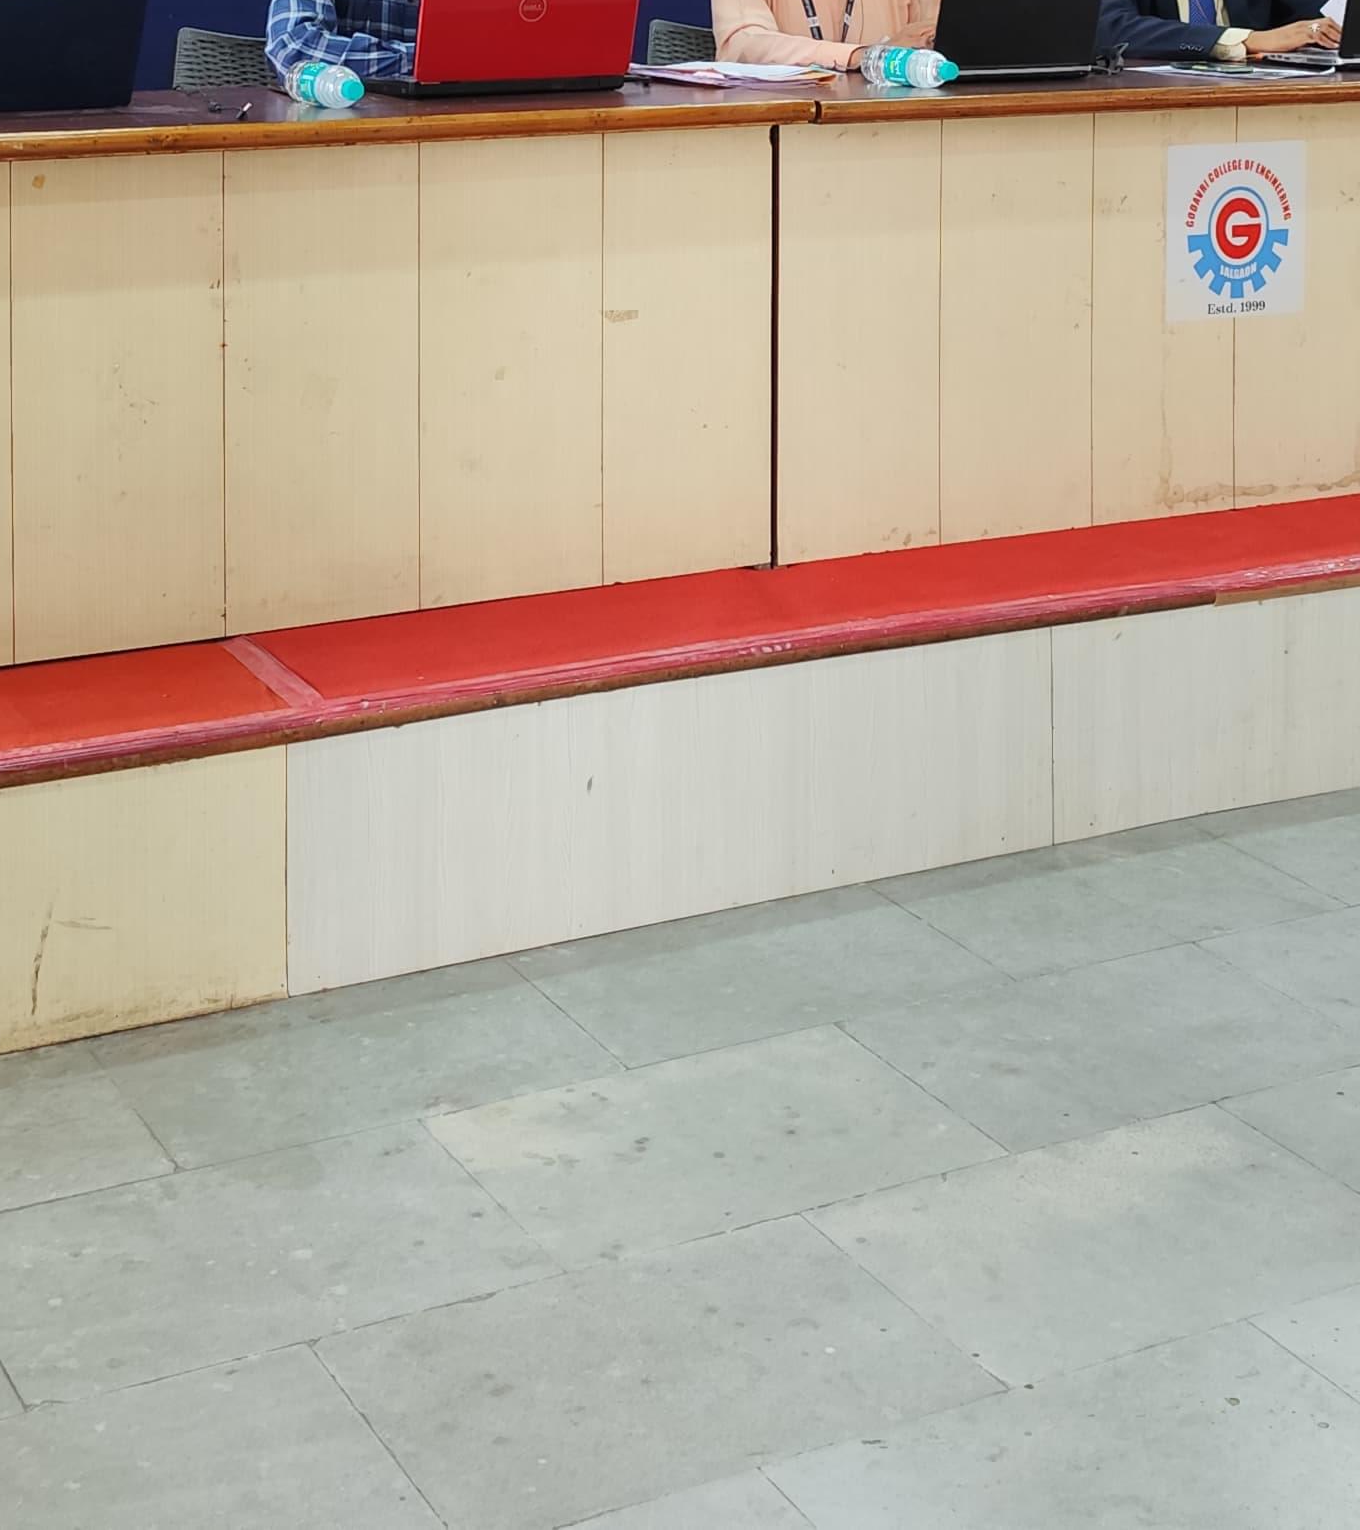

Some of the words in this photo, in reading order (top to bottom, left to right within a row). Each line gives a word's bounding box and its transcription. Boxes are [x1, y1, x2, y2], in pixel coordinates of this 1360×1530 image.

[1185, 180, 1210, 228] GODAVARI
[1208, 159, 1242, 183] COLLEGE
[1244, 160, 1255, 171] OF
[1255, 162, 1292, 221] ENGINEERING
[1215, 197, 1262, 259] G
[1207, 303, 1237, 315] Estd.
[1240, 300, 1266, 313] 1999
